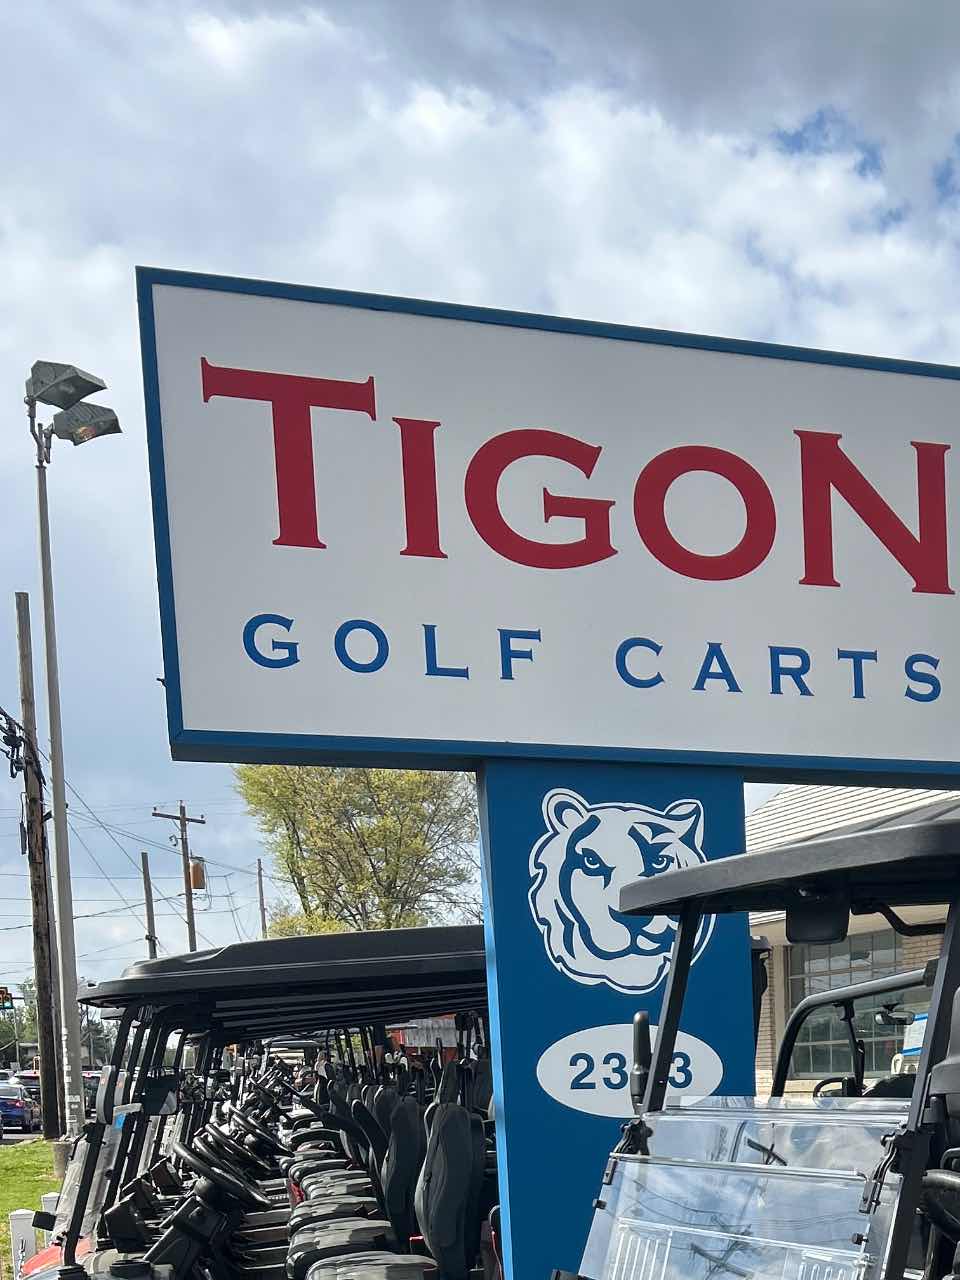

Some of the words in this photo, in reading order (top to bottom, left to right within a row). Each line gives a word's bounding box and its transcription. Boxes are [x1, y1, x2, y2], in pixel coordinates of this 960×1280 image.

[201, 357, 955, 595] TIGON
[242, 613, 542, 681] GOLF
[615, 637, 942, 703] CARTS
[569, 1052, 693, 1090] 233
